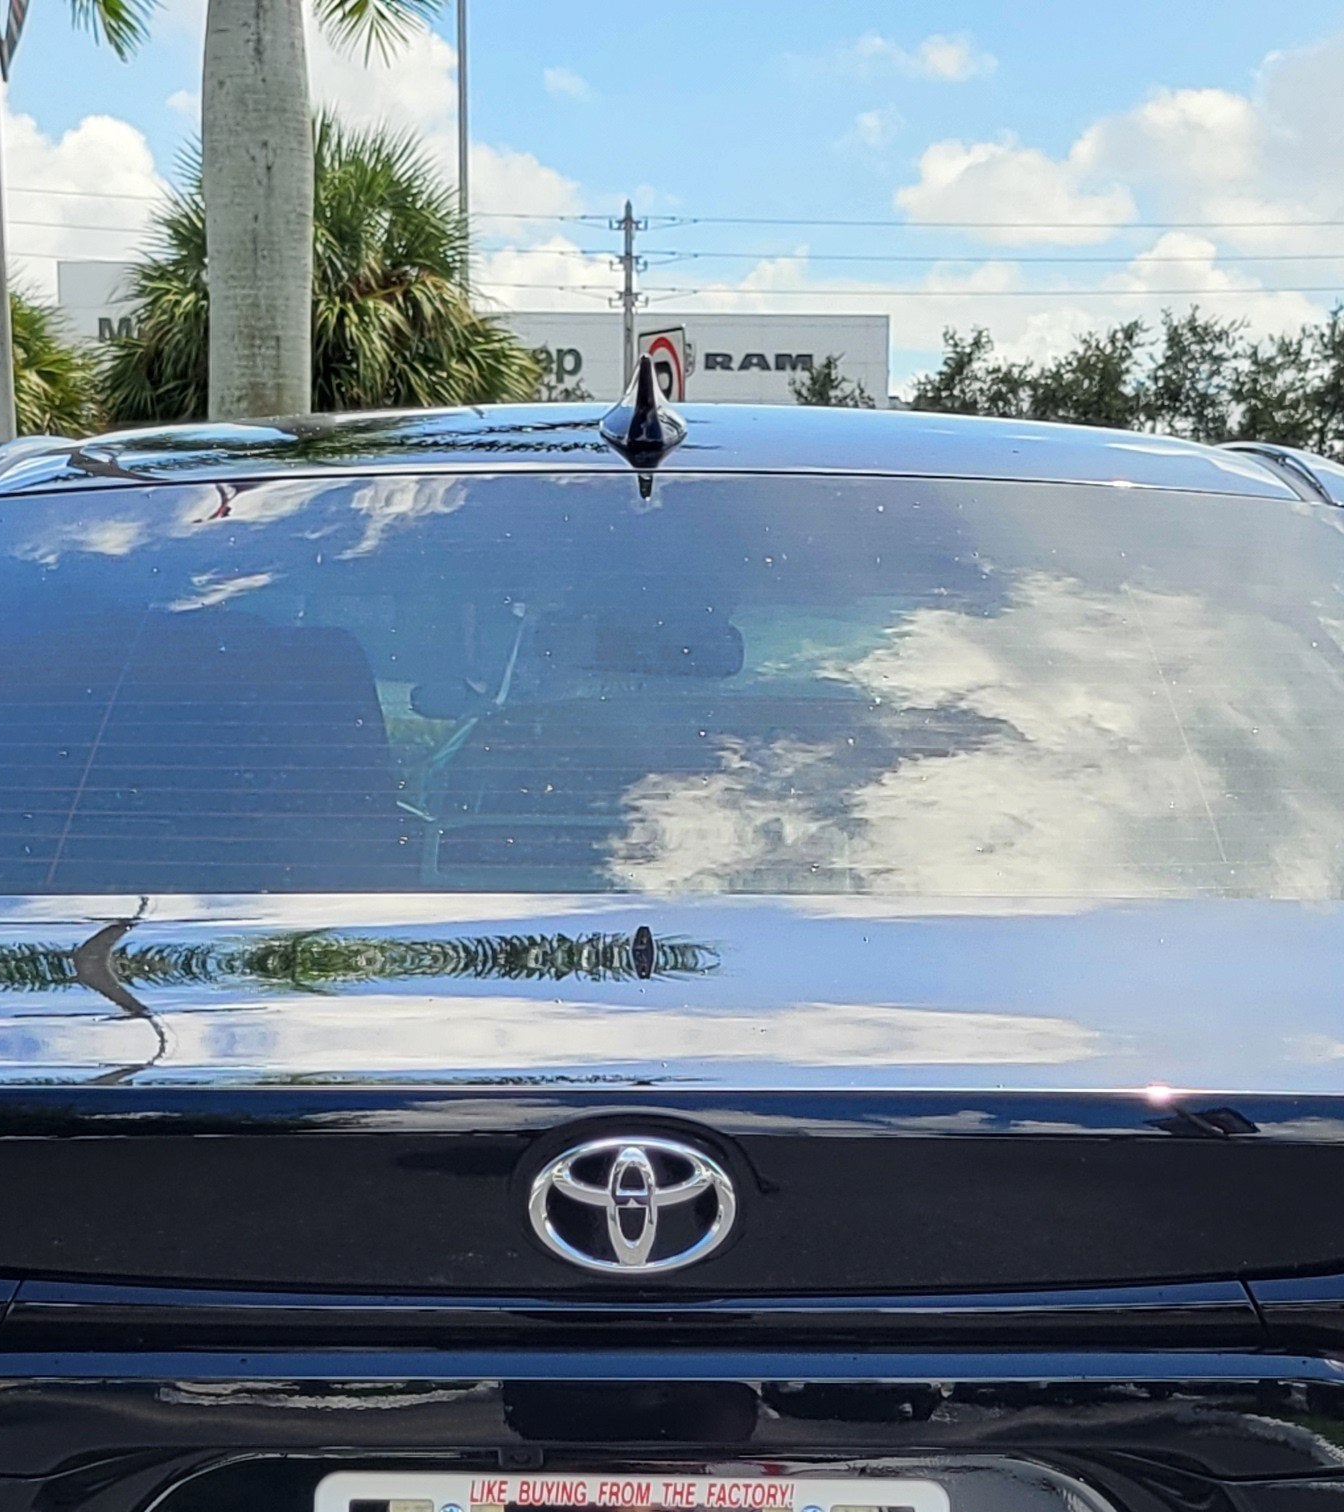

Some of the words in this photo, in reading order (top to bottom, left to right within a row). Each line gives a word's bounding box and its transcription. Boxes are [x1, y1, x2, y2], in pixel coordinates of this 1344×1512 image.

[704, 353, 813, 371] RAM
[469, 1480, 509, 1503] LIKE
[518, 1480, 587, 1505] BUYING
[597, 1481, 652, 1506] FROM
[662, 1482, 697, 1506] THE
[706, 1483, 795, 1506] FACTORY!
